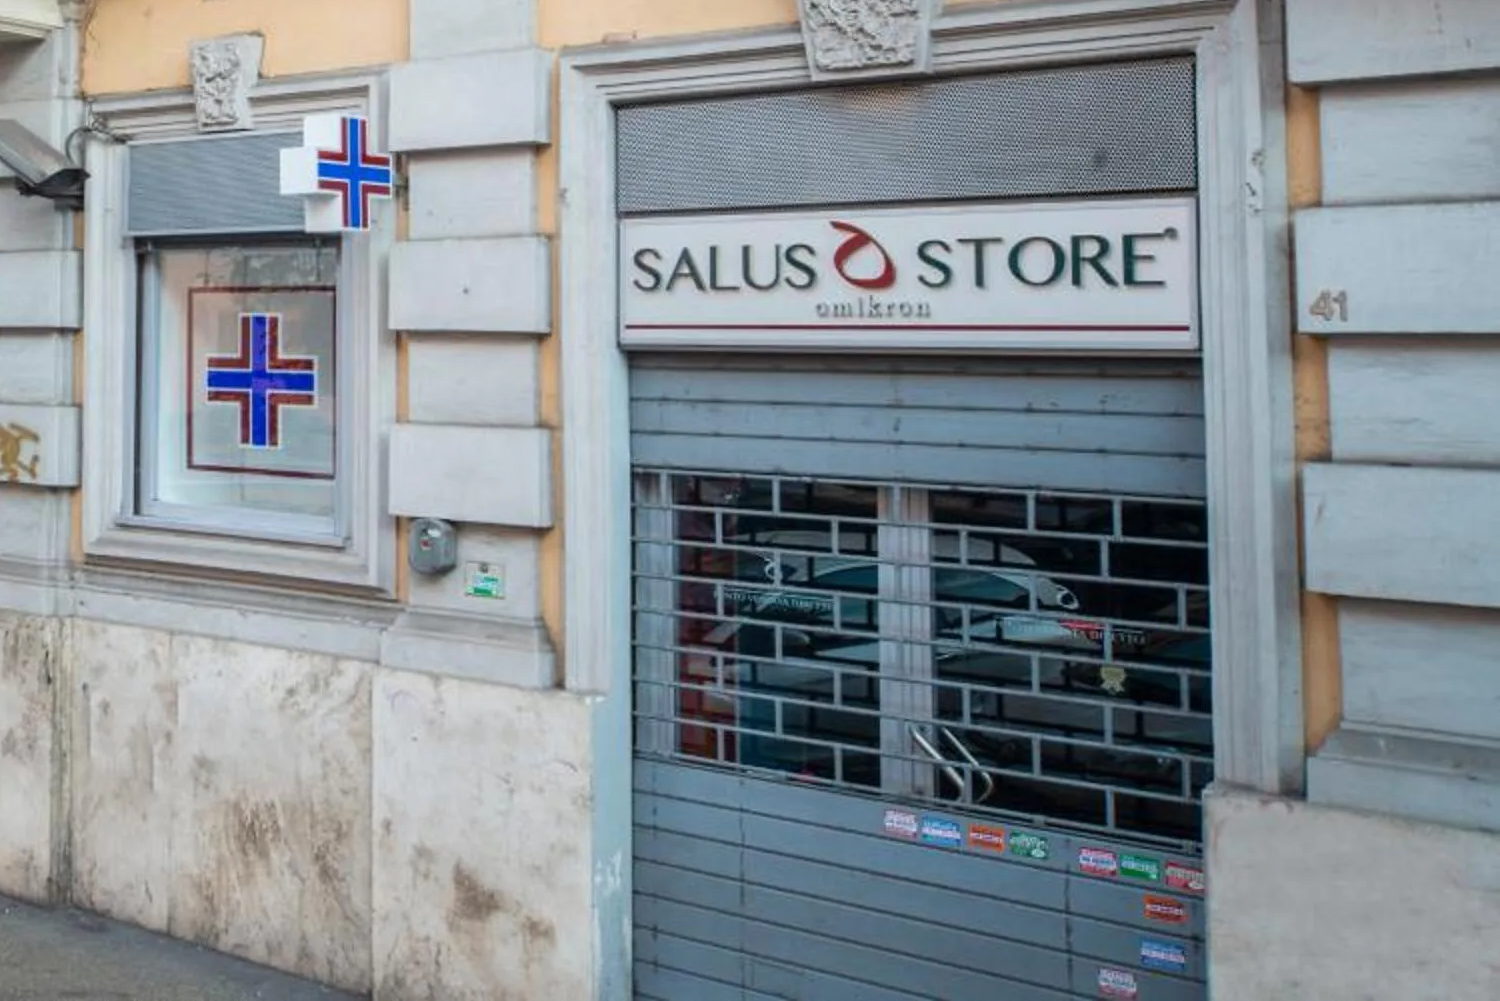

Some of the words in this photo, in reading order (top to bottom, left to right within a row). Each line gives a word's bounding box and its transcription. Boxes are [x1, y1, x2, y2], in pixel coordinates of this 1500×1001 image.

[633, 244, 817, 292] SALUS
[917, 228, 1178, 289] STORE
[815, 295, 931, 318] omikron
[1309, 290, 1348, 322] 41
